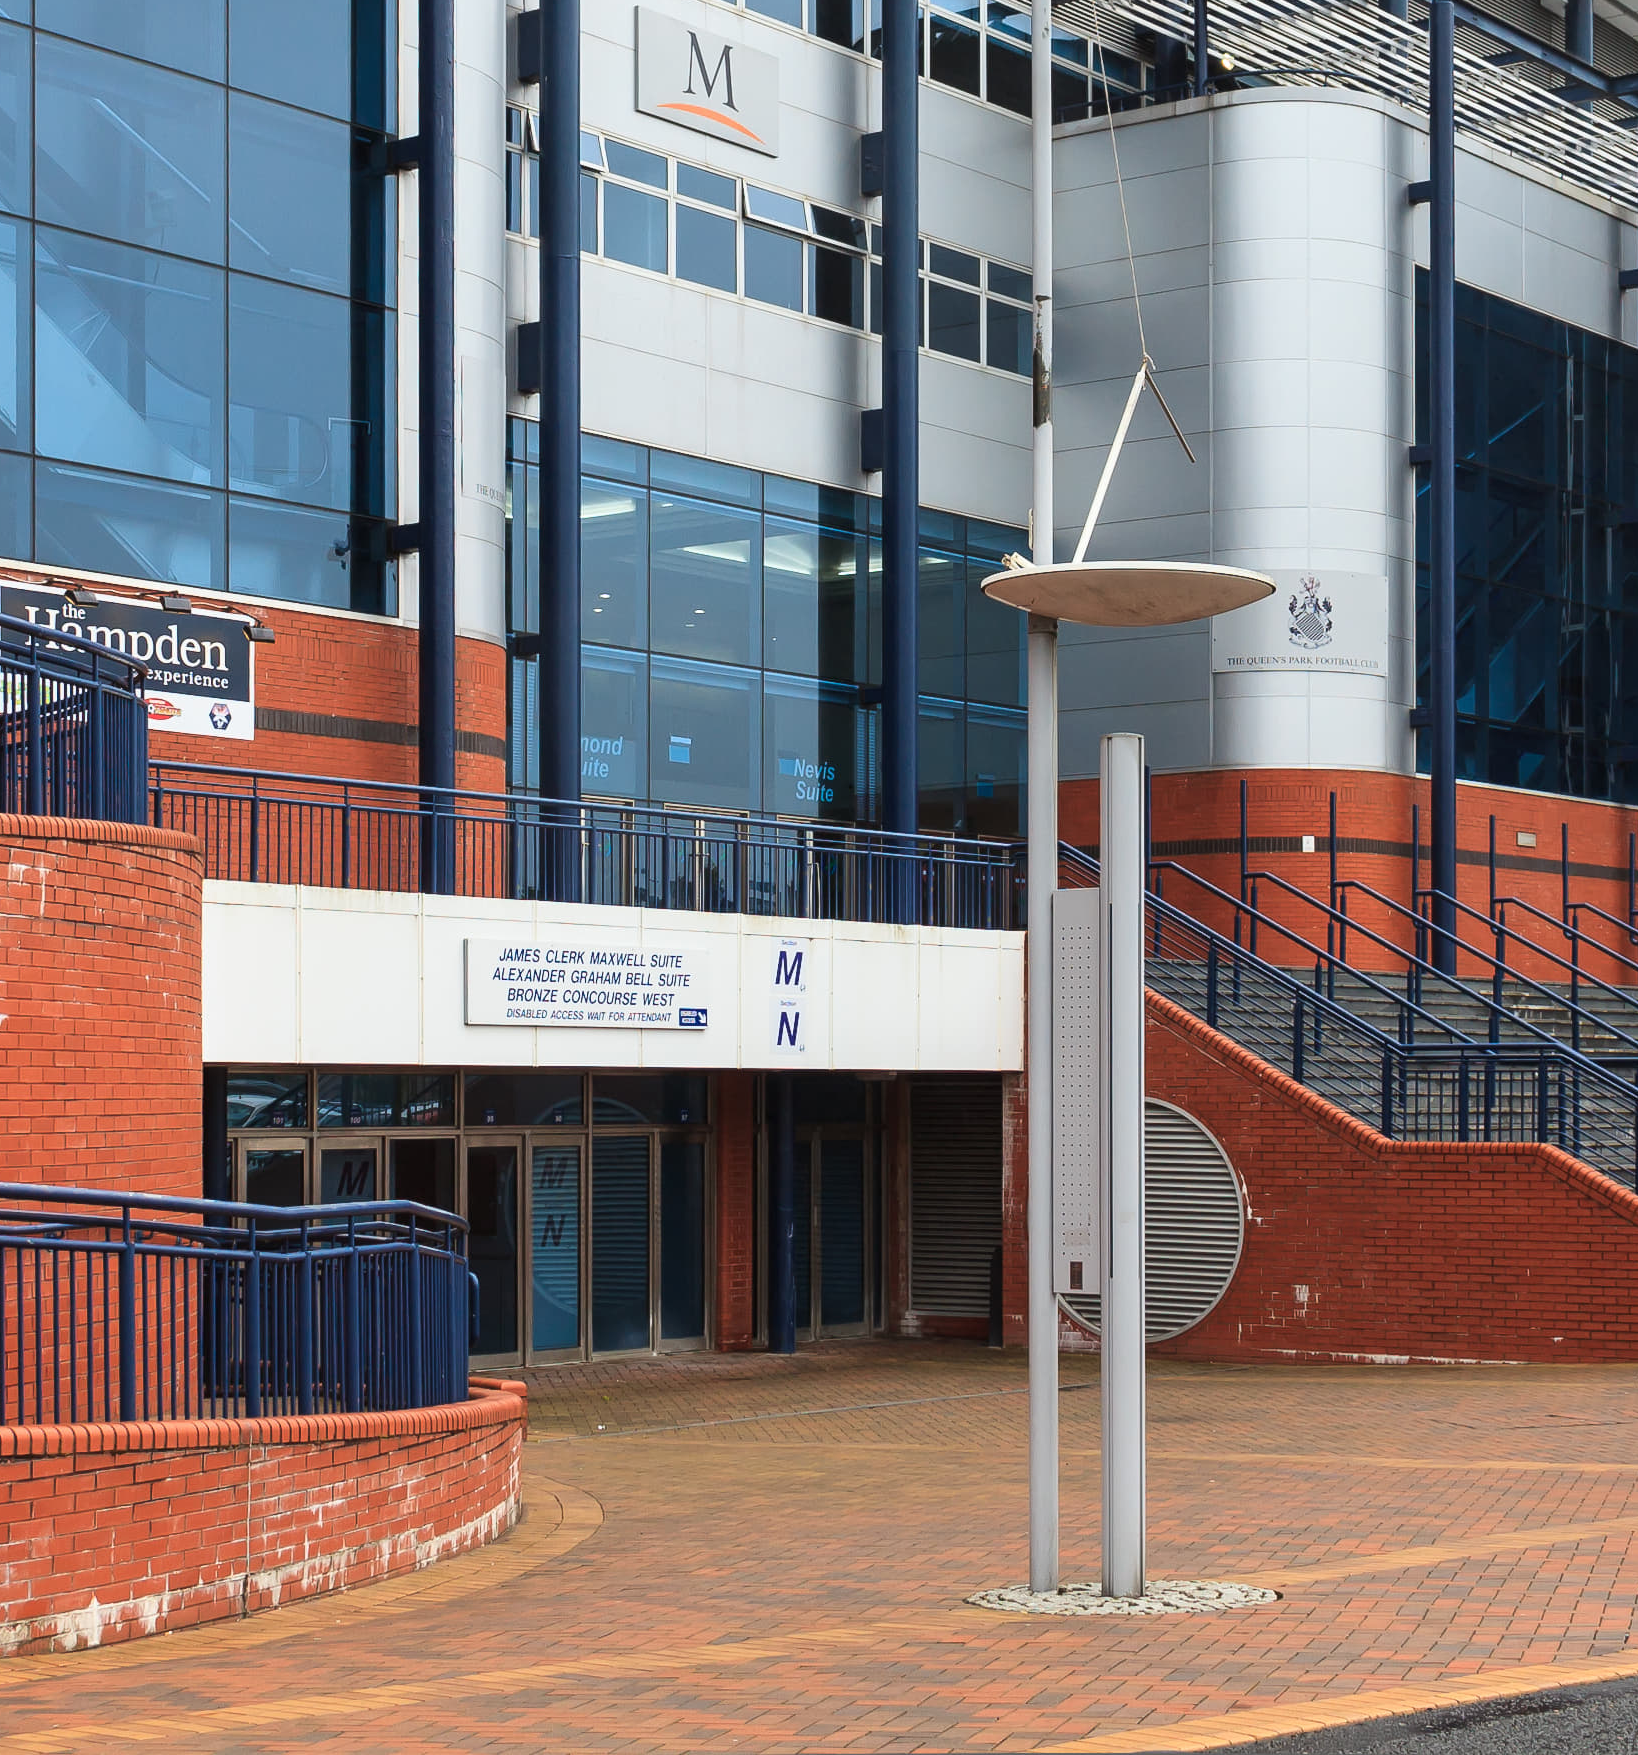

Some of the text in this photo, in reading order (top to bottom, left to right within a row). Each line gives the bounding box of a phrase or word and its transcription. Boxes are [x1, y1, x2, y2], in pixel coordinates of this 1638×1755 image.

[682, 30, 740, 113] M
[62, 603, 86, 619] the
[24, 605, 229, 676] Hampden
[1227, 657, 1245, 666] THE
[1246, 656, 1286, 666] QUEEN'S
[1288, 656, 1313, 665] PARK
[1315, 657, 1360, 667] FOOTBALL
[147, 669, 229, 689] experience
[793, 758, 835, 781] Nevis
[795, 780, 834, 802] Suite
[499, 948, 683, 968] JAMES CLERK MAXWELL SUITE
[775, 950, 803, 985] M
[493, 967, 691, 987] ALEXANDER GRAHAM BELL SUITE
[507, 988, 675, 1006] BRONZE CONCOURSE WEST
[506, 1008, 548, 1019] DISABLED
[550, 1009, 584, 1020] ACCESS
[587, 1010, 606, 1021] WAIT
[608, 1011, 626, 1022] FOR
[627, 1012, 672, 1022] ATTENDANT
[776, 1011, 800, 1046] N
[337, 1161, 370, 1196] M
[540, 1213, 566, 1247] N
